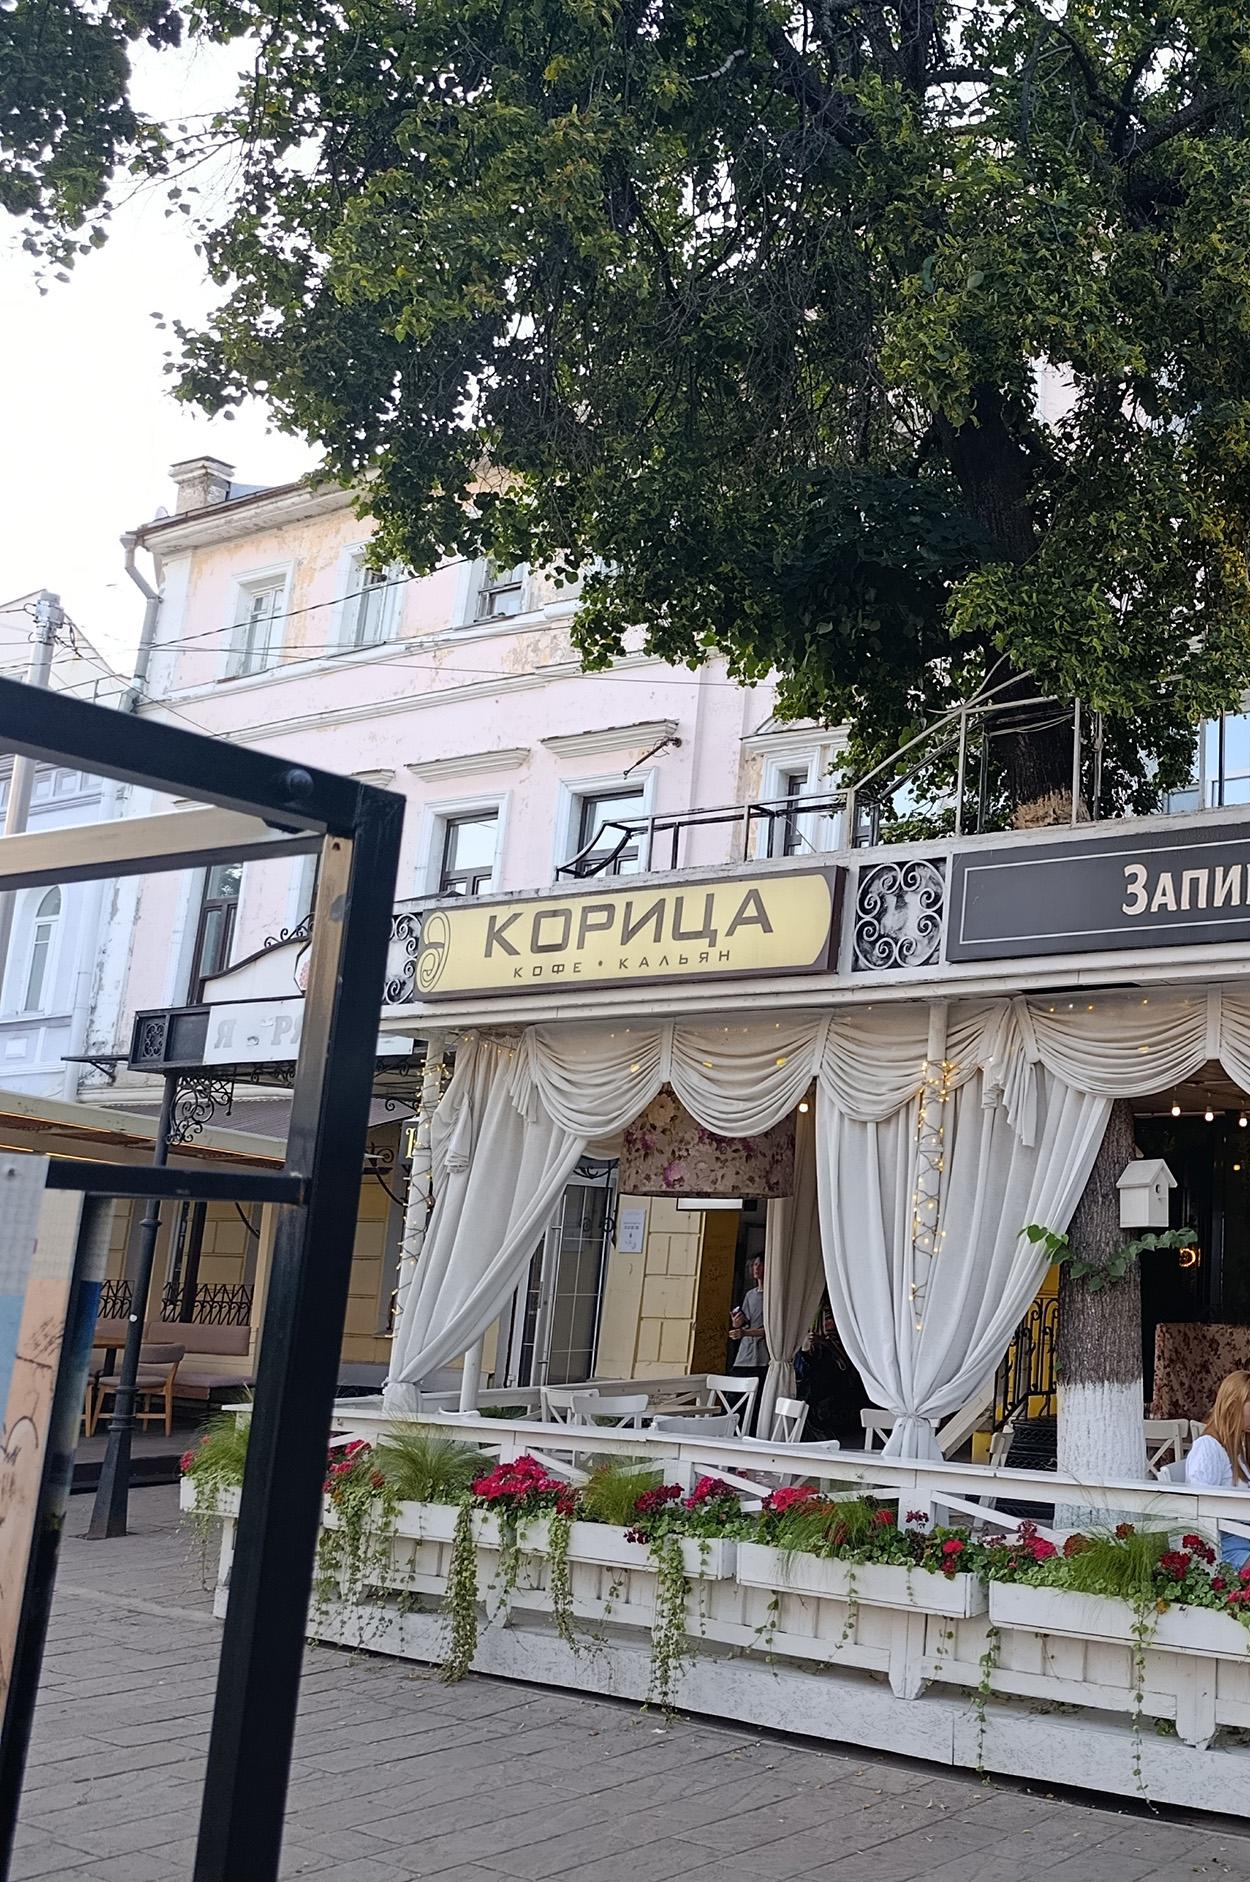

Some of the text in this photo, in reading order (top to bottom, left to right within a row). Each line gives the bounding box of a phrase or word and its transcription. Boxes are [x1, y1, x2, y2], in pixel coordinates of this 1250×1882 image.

[483, 888, 775, 959] КОРИЦА
[513, 949, 731, 979] КОФЕ КАЛЬЯН
